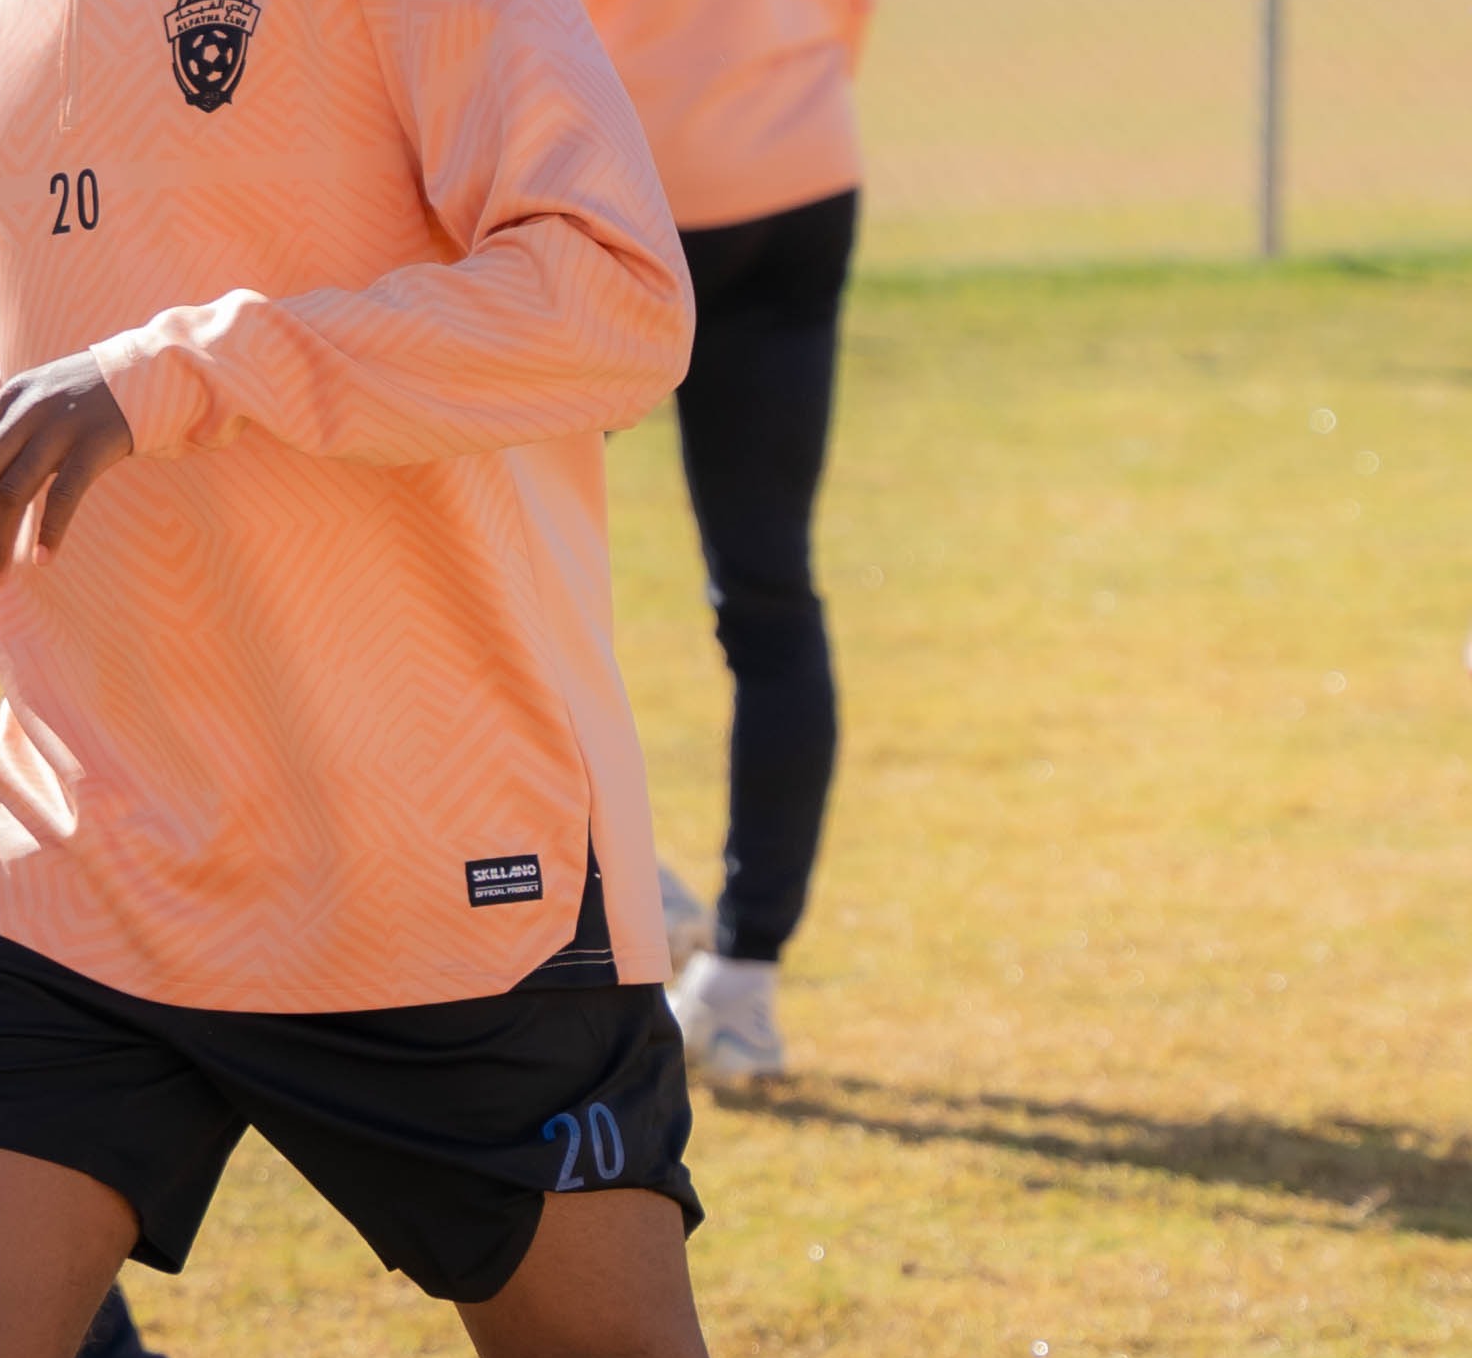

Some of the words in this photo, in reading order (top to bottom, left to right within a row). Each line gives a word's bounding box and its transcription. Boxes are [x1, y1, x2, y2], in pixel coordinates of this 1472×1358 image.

[223, 14, 248, 28] CLUB
[49, 168, 100, 235] 20
[472, 864, 537, 882] SKILLANO
[475, 888, 506, 899] OFFICIAL
[507, 885, 539, 895] PRODUCT
[540, 1101, 625, 1192] 20
